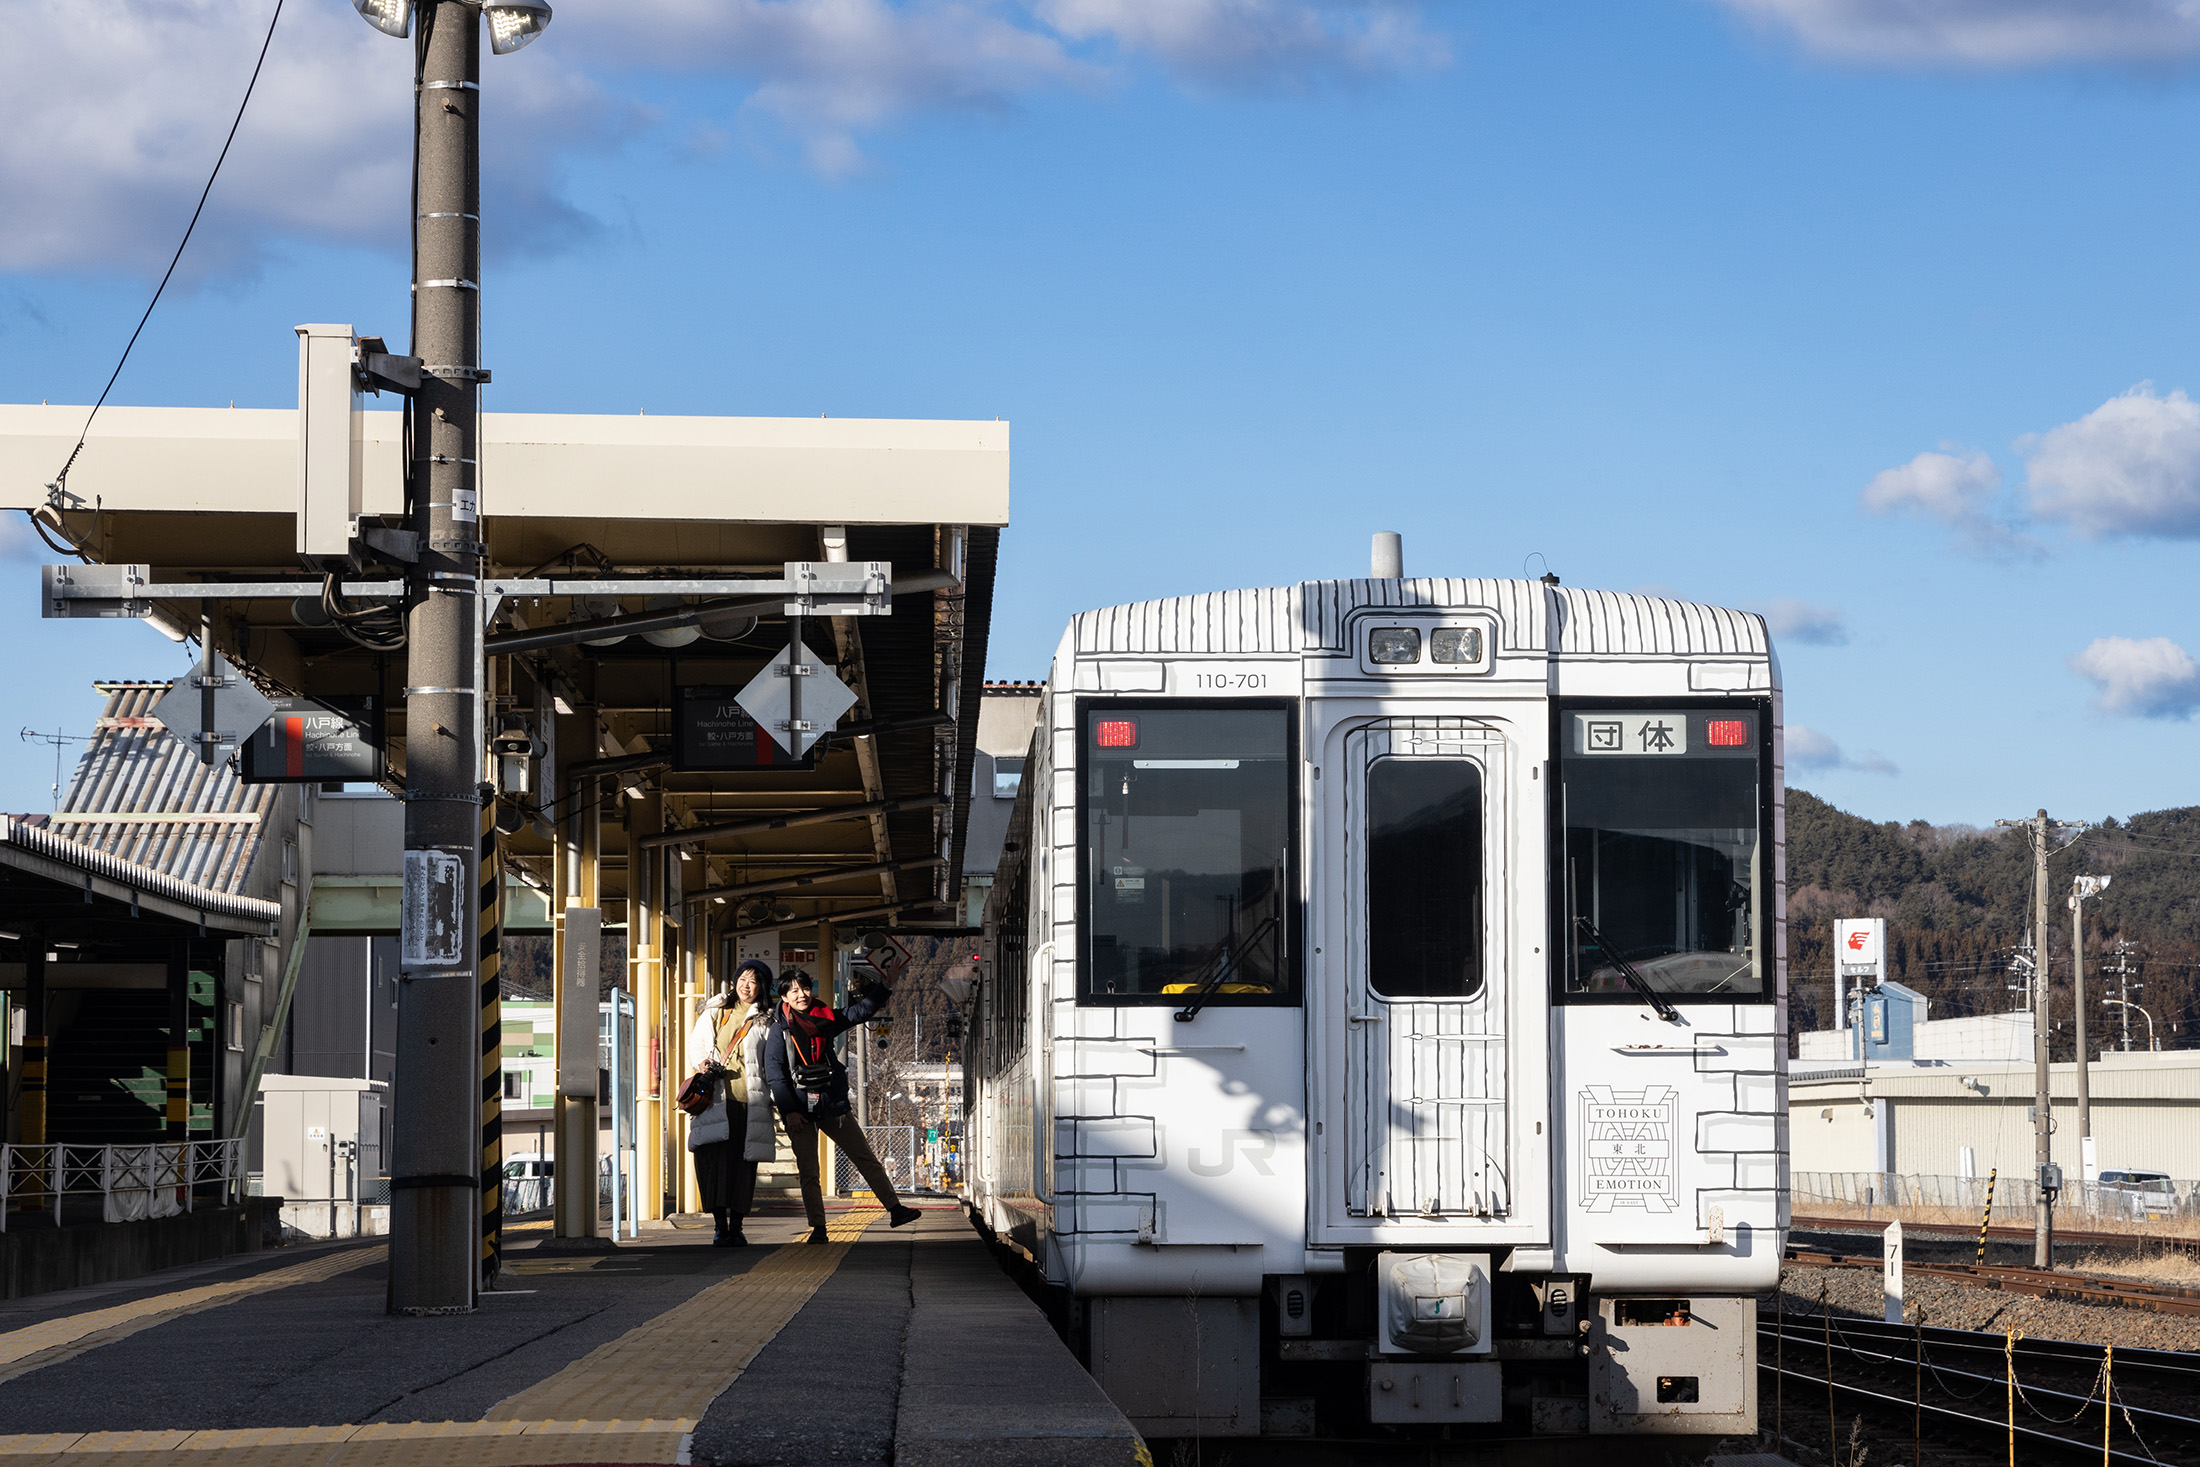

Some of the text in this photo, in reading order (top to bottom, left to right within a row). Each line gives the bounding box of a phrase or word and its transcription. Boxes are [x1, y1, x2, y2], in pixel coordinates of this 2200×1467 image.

[1197, 674, 1266, 688] 110-701
[306, 717, 344, 729] 八戸線
[264, 718, 275, 747] 1
[305, 731, 344, 739] Hachinohe
[1588, 720, 1674, 752] 団体
[880, 946, 896, 969] 2
[1596, 1109, 1661, 1118] TOHOKU
[1188, 1129, 1276, 1177] JR
[1613, 1144, 1646, 1154] 東北
[1596, 1180, 1661, 1189] EMOTION
